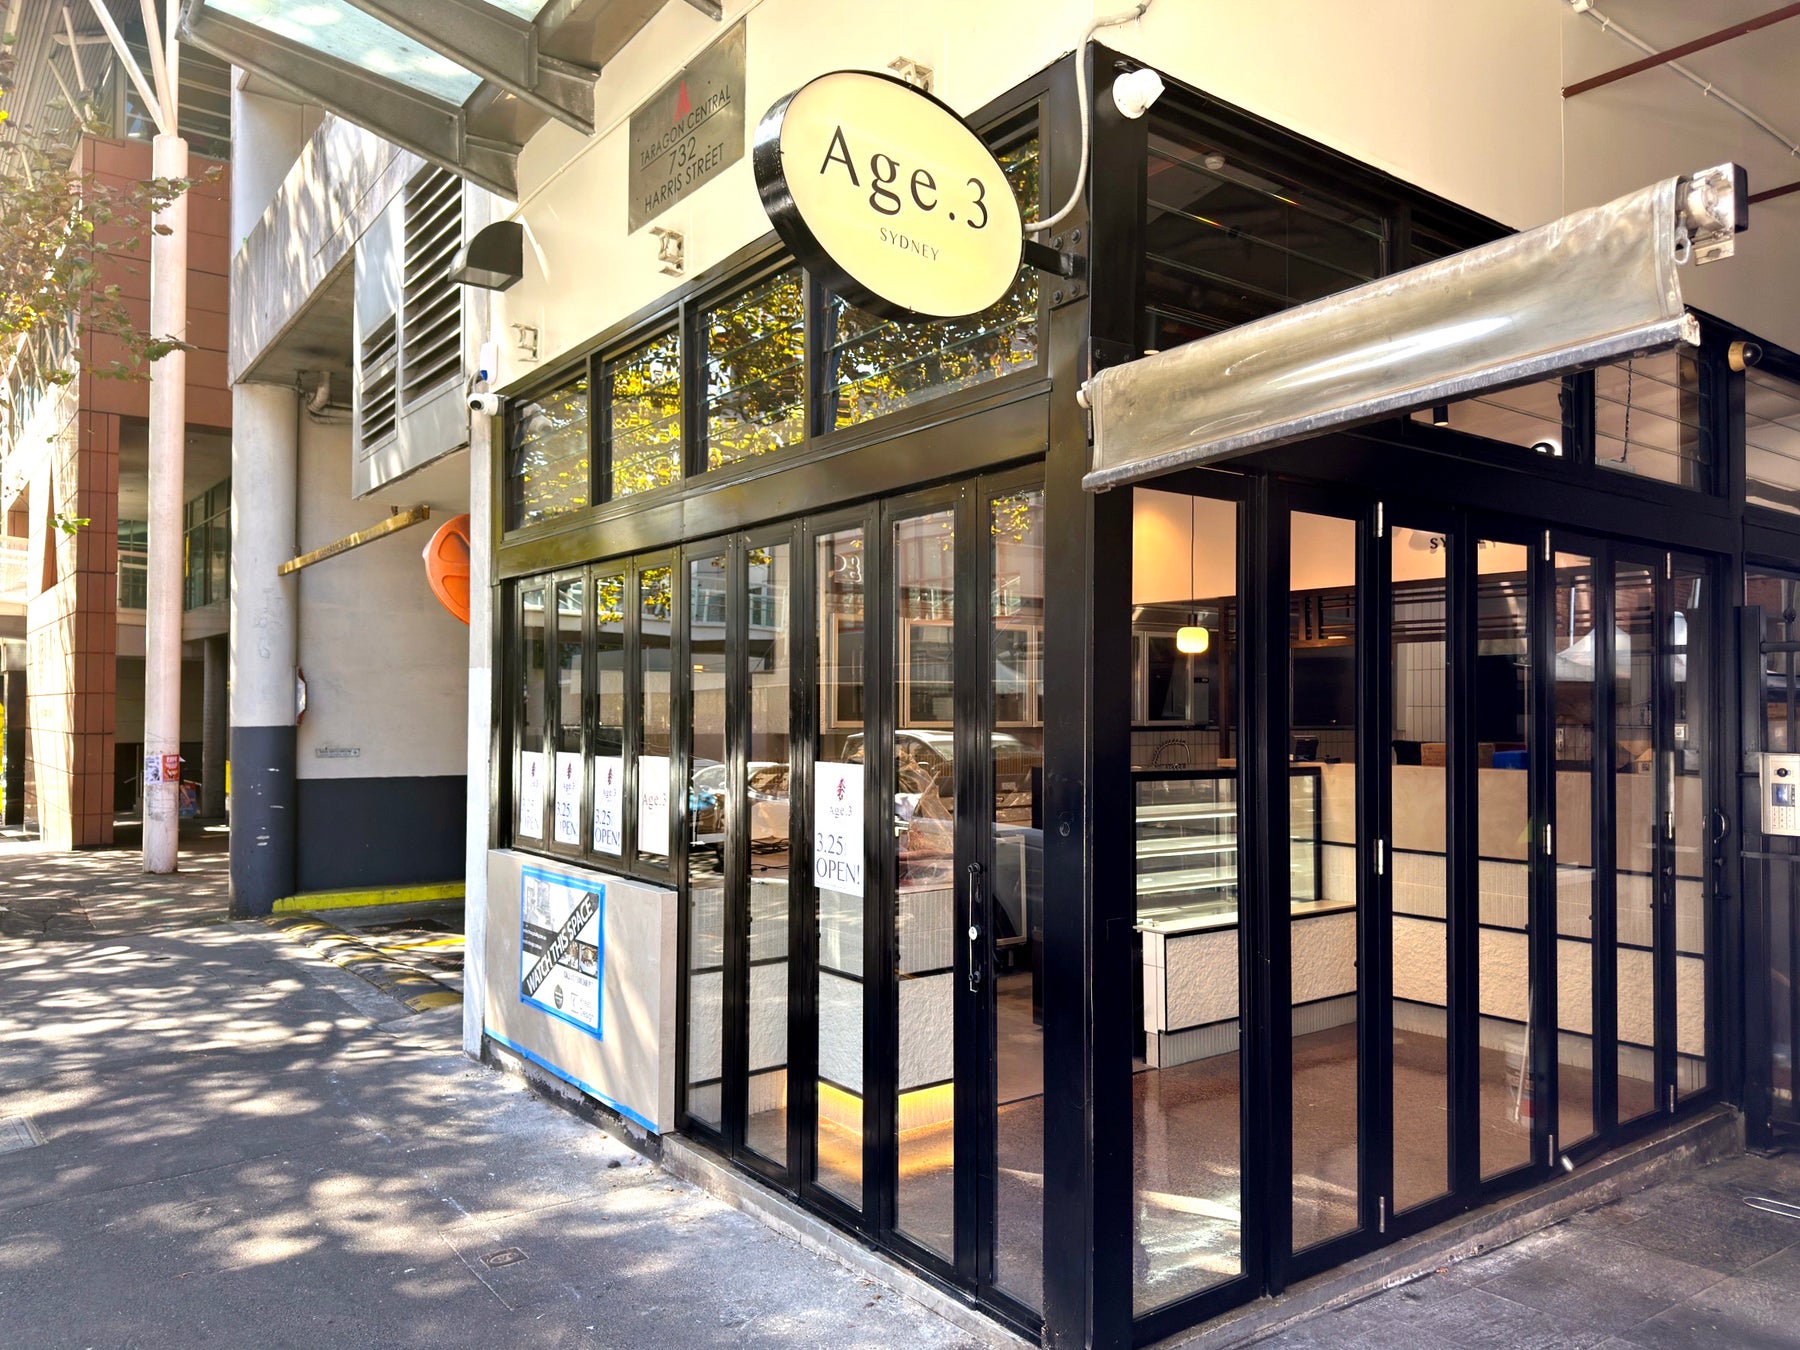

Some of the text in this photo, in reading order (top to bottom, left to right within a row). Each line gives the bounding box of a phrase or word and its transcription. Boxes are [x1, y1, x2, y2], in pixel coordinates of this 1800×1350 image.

[640, 85, 731, 166] TARAGON CENTRAL
[669, 136, 696, 175] 732
[645, 142, 724, 213] HARRIS STREET
[819, 125, 988, 229] Age.3
[879, 227, 939, 261] SYDNEY
[595, 827, 620, 847] OPEN!
[816, 832, 844, 856] 3.25
[816, 857, 861, 885] OPEN!
[526, 950, 554, 995] WATCH
[549, 928, 569, 960] THIS
[567, 895, 594, 941] SPACE
